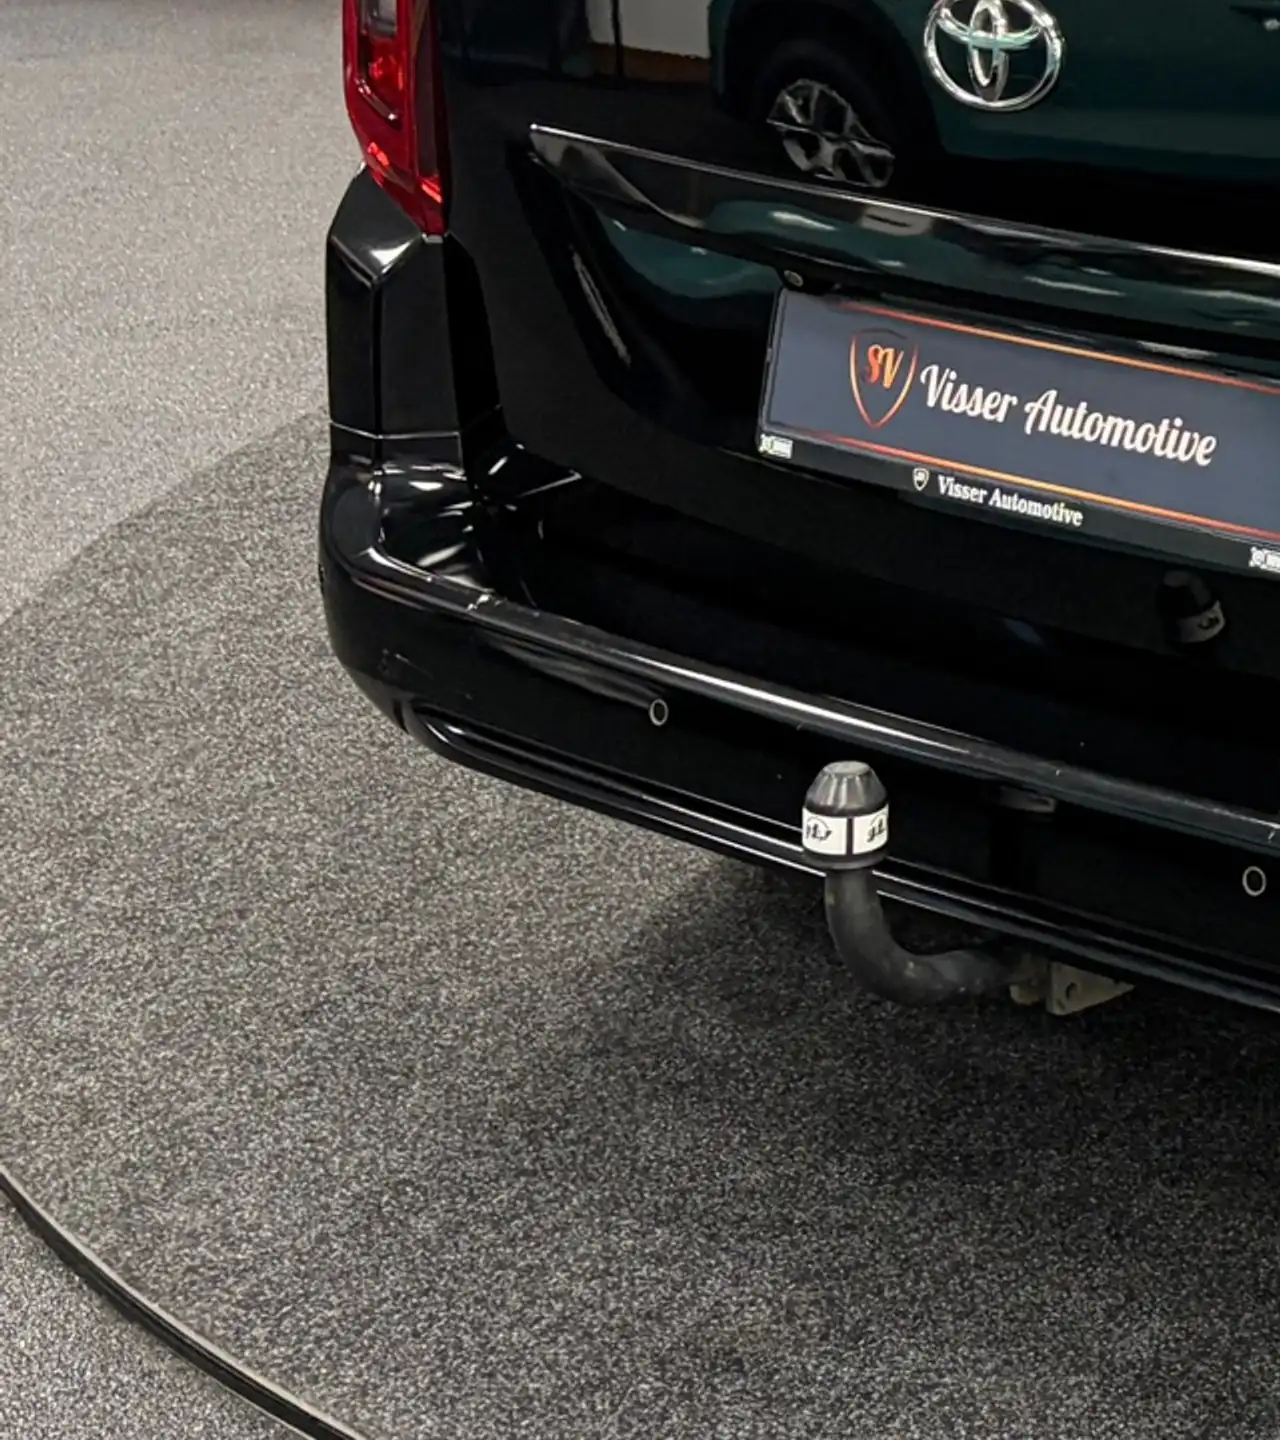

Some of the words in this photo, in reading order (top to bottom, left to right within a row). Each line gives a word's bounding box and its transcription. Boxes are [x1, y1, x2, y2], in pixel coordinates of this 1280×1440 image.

[919, 363, 1019, 424] Visser
[1023, 388, 1218, 467] Automotive
[937, 474, 988, 504] Visser
[988, 487, 1084, 527] Automotive
